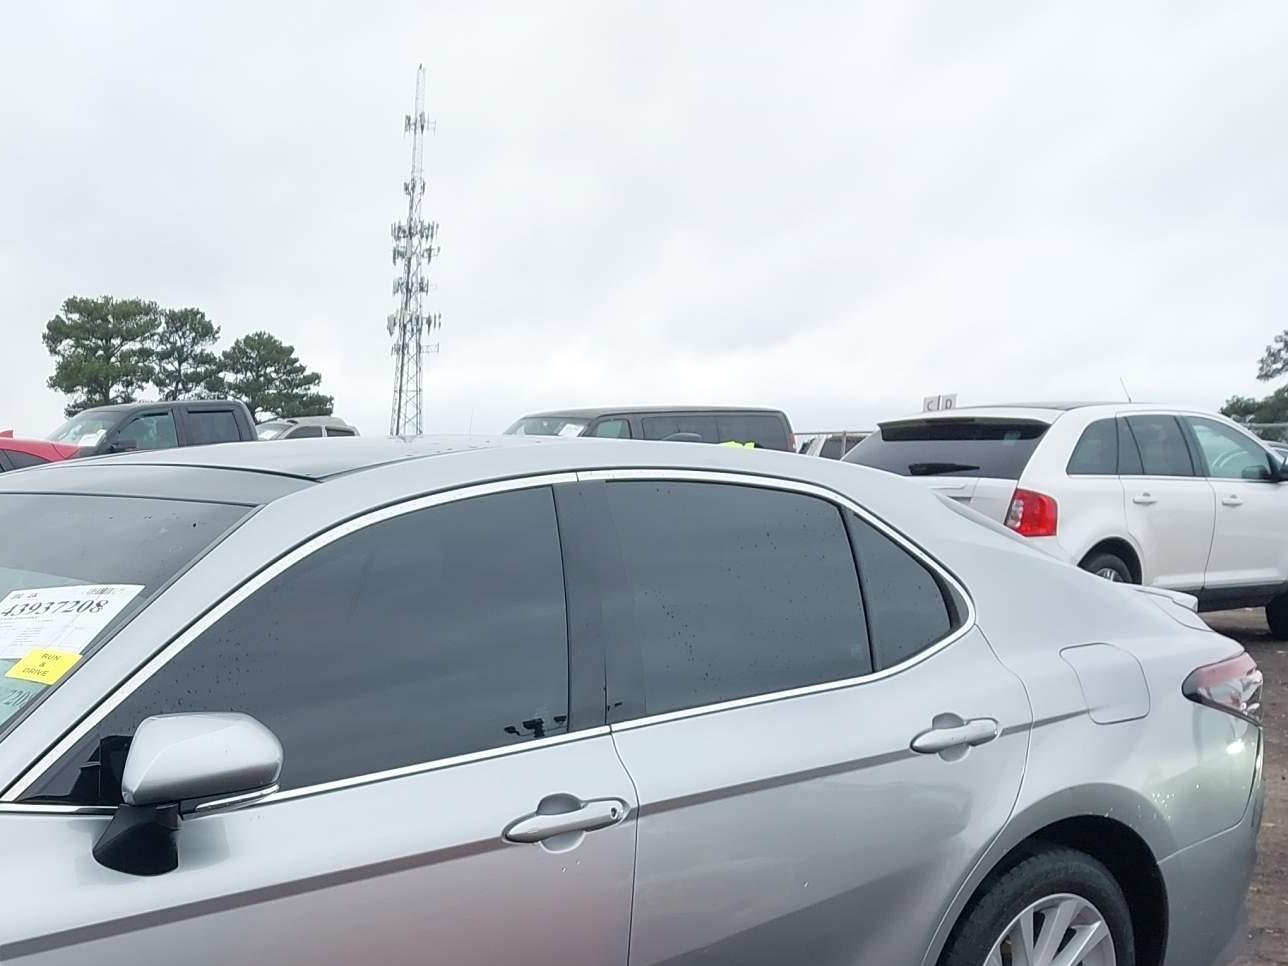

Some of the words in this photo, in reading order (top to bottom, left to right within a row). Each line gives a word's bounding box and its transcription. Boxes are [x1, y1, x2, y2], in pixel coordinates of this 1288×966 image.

[0, 599, 110, 617] 43937208
[40, 652, 63, 662] RUN
[21, 667, 50, 677] DRIVE
